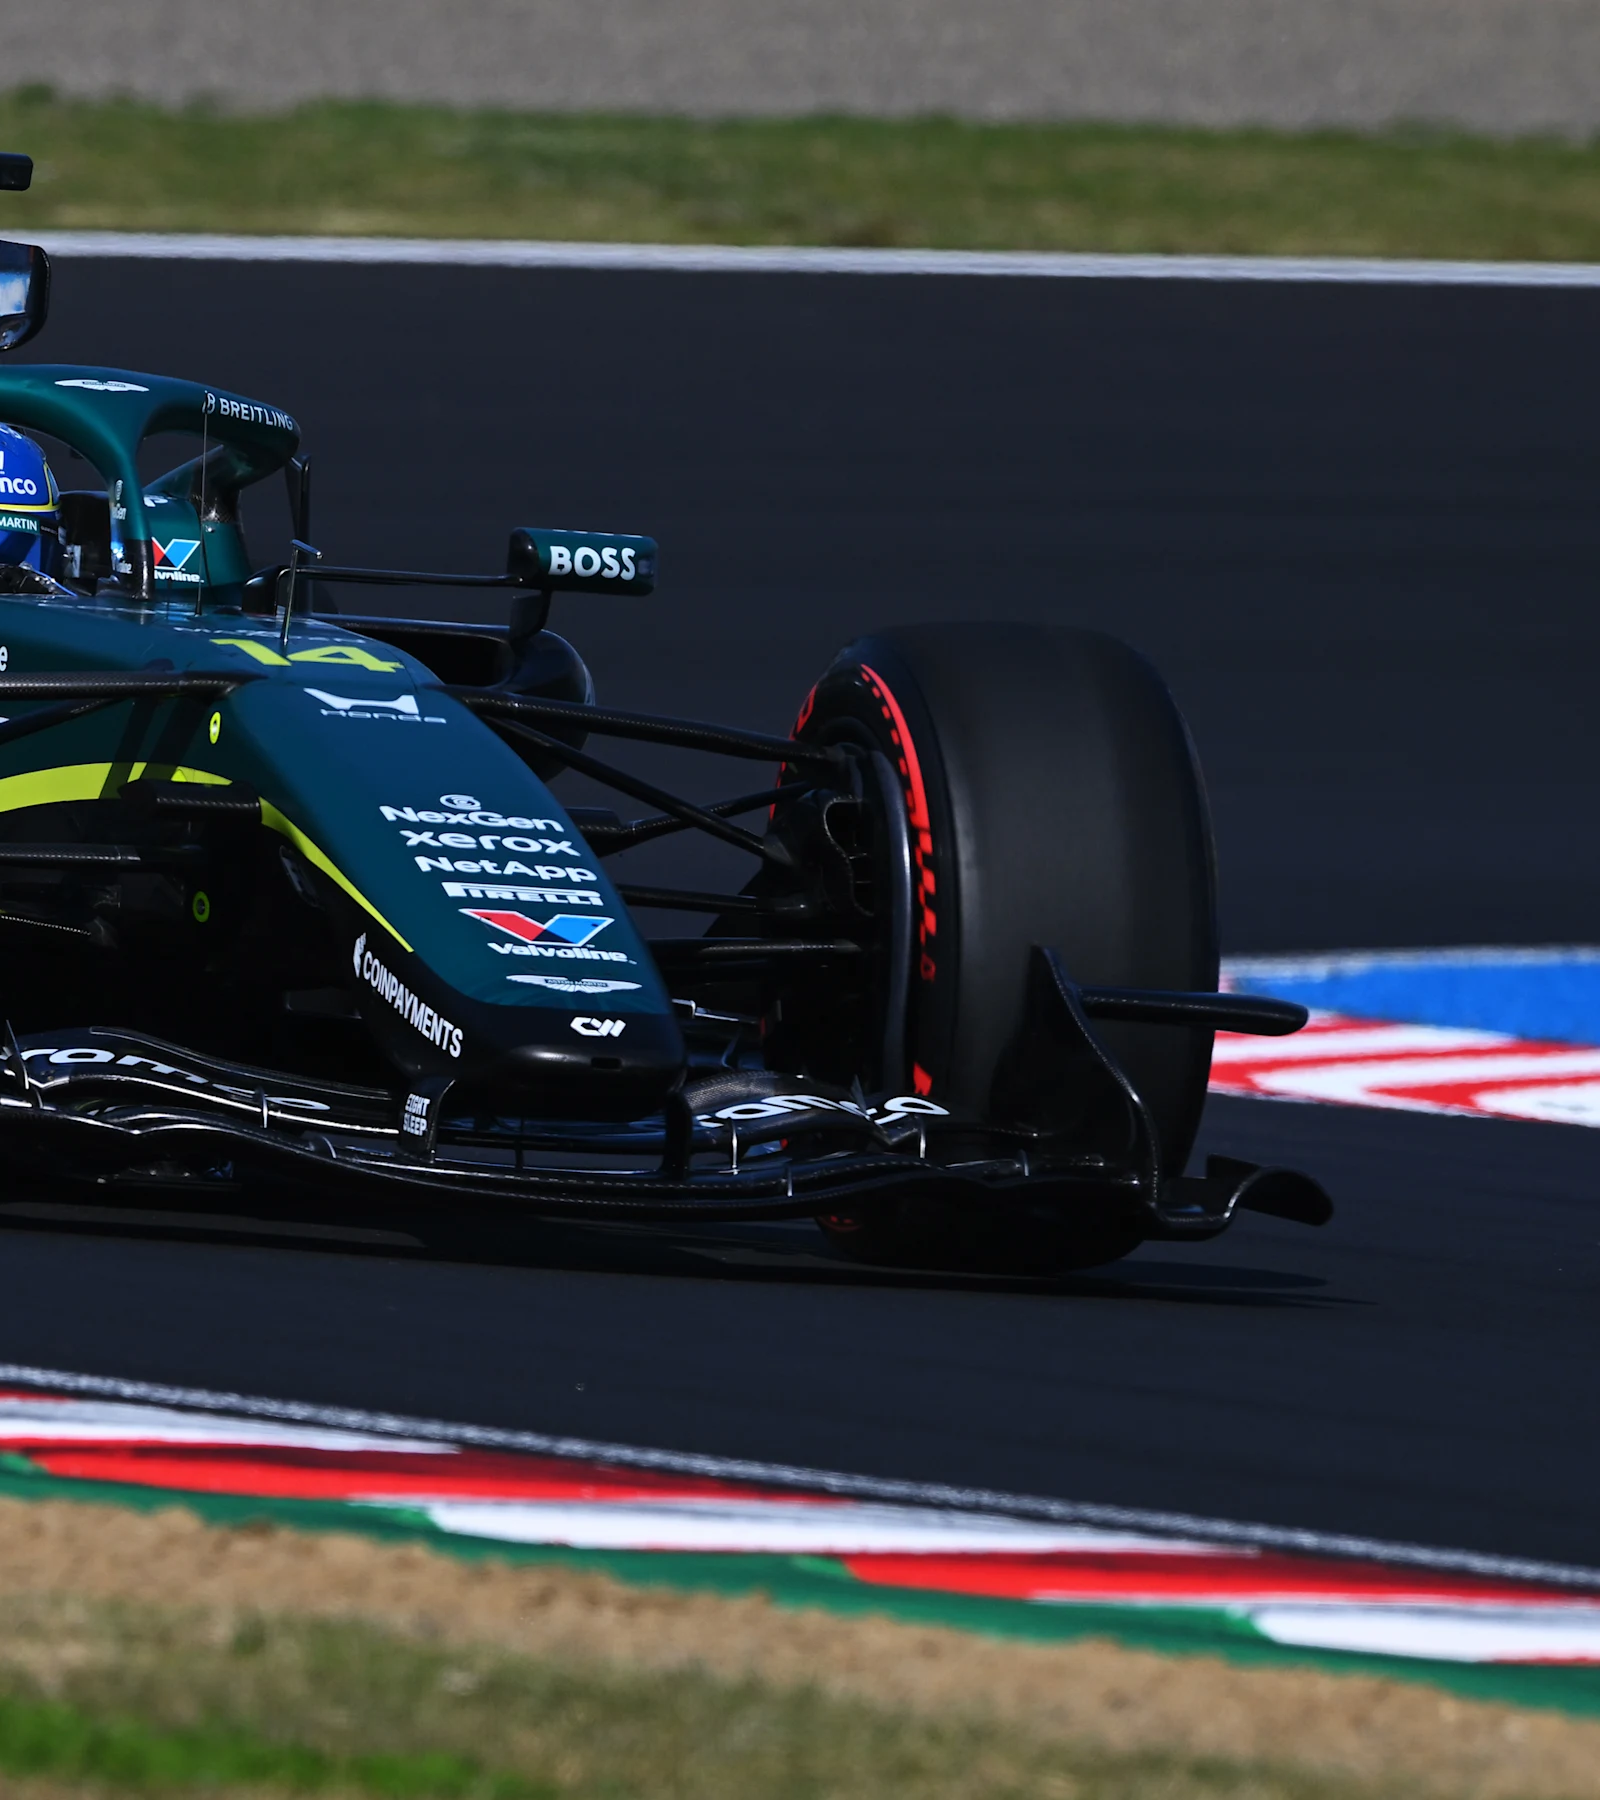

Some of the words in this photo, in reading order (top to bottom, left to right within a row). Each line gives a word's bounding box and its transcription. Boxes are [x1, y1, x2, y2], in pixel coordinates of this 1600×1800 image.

[219, 397, 293, 431] BREITLING
[548, 545, 637, 581] BOSS
[210, 638, 405, 673] 14
[379, 805, 565, 832] NexGen
[399, 829, 581, 857] xerox
[414, 855, 597, 882] NetApp
[441, 881, 604, 906] PIRELLI
[362, 950, 463, 1059] COINPAYMENTS
[404, 1093, 431, 1117] EIGHT
[403, 1112, 428, 1137] SLEEP
